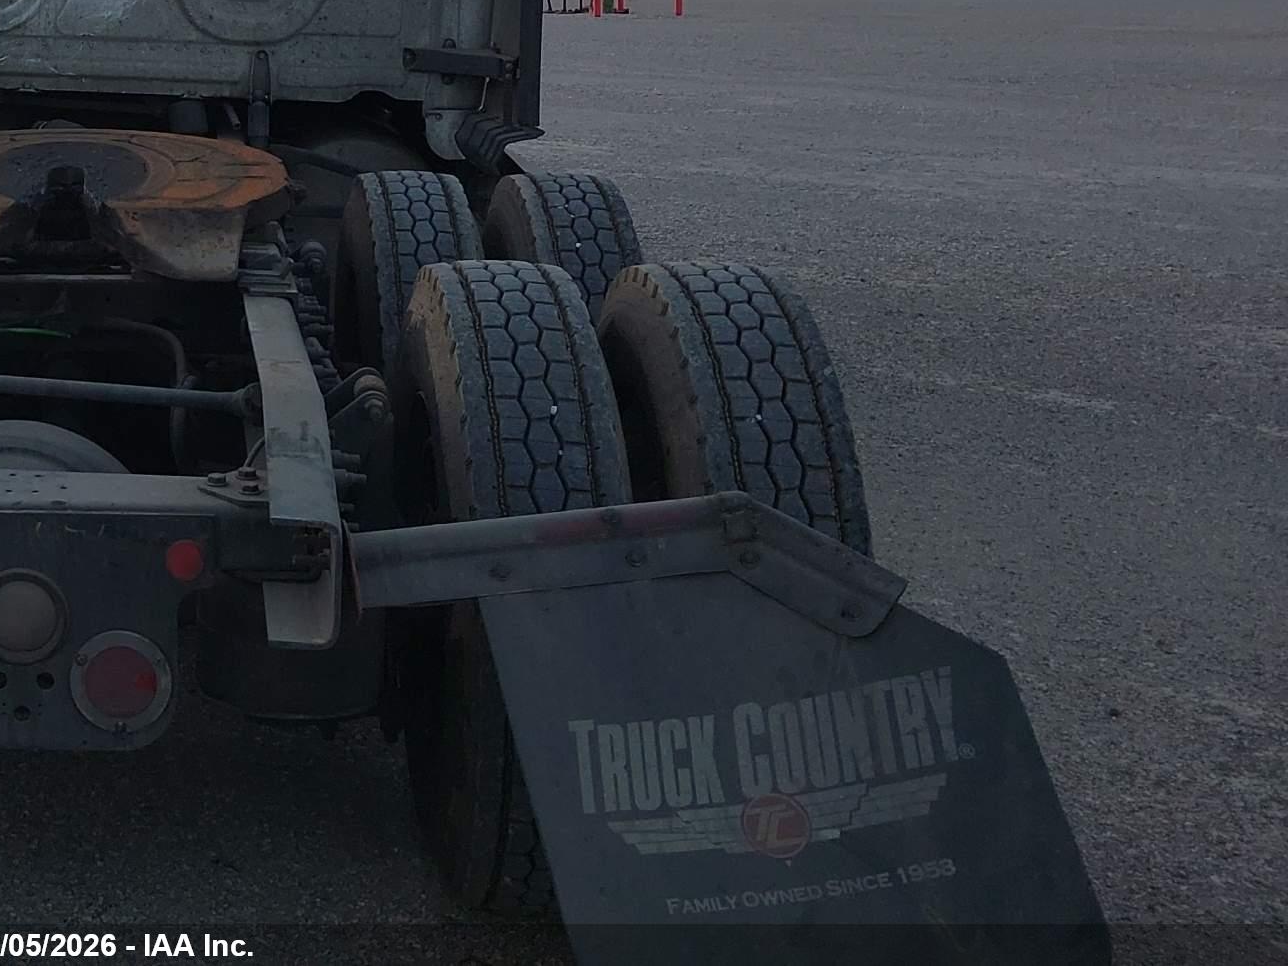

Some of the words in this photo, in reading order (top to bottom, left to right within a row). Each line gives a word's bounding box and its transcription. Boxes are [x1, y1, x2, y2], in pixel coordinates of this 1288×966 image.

[568, 714, 726, 814] TRUCK
[665, 894, 739, 915] FAMILY
[741, 884, 823, 908] OWNED
[824, 872, 893, 897] SINCE
